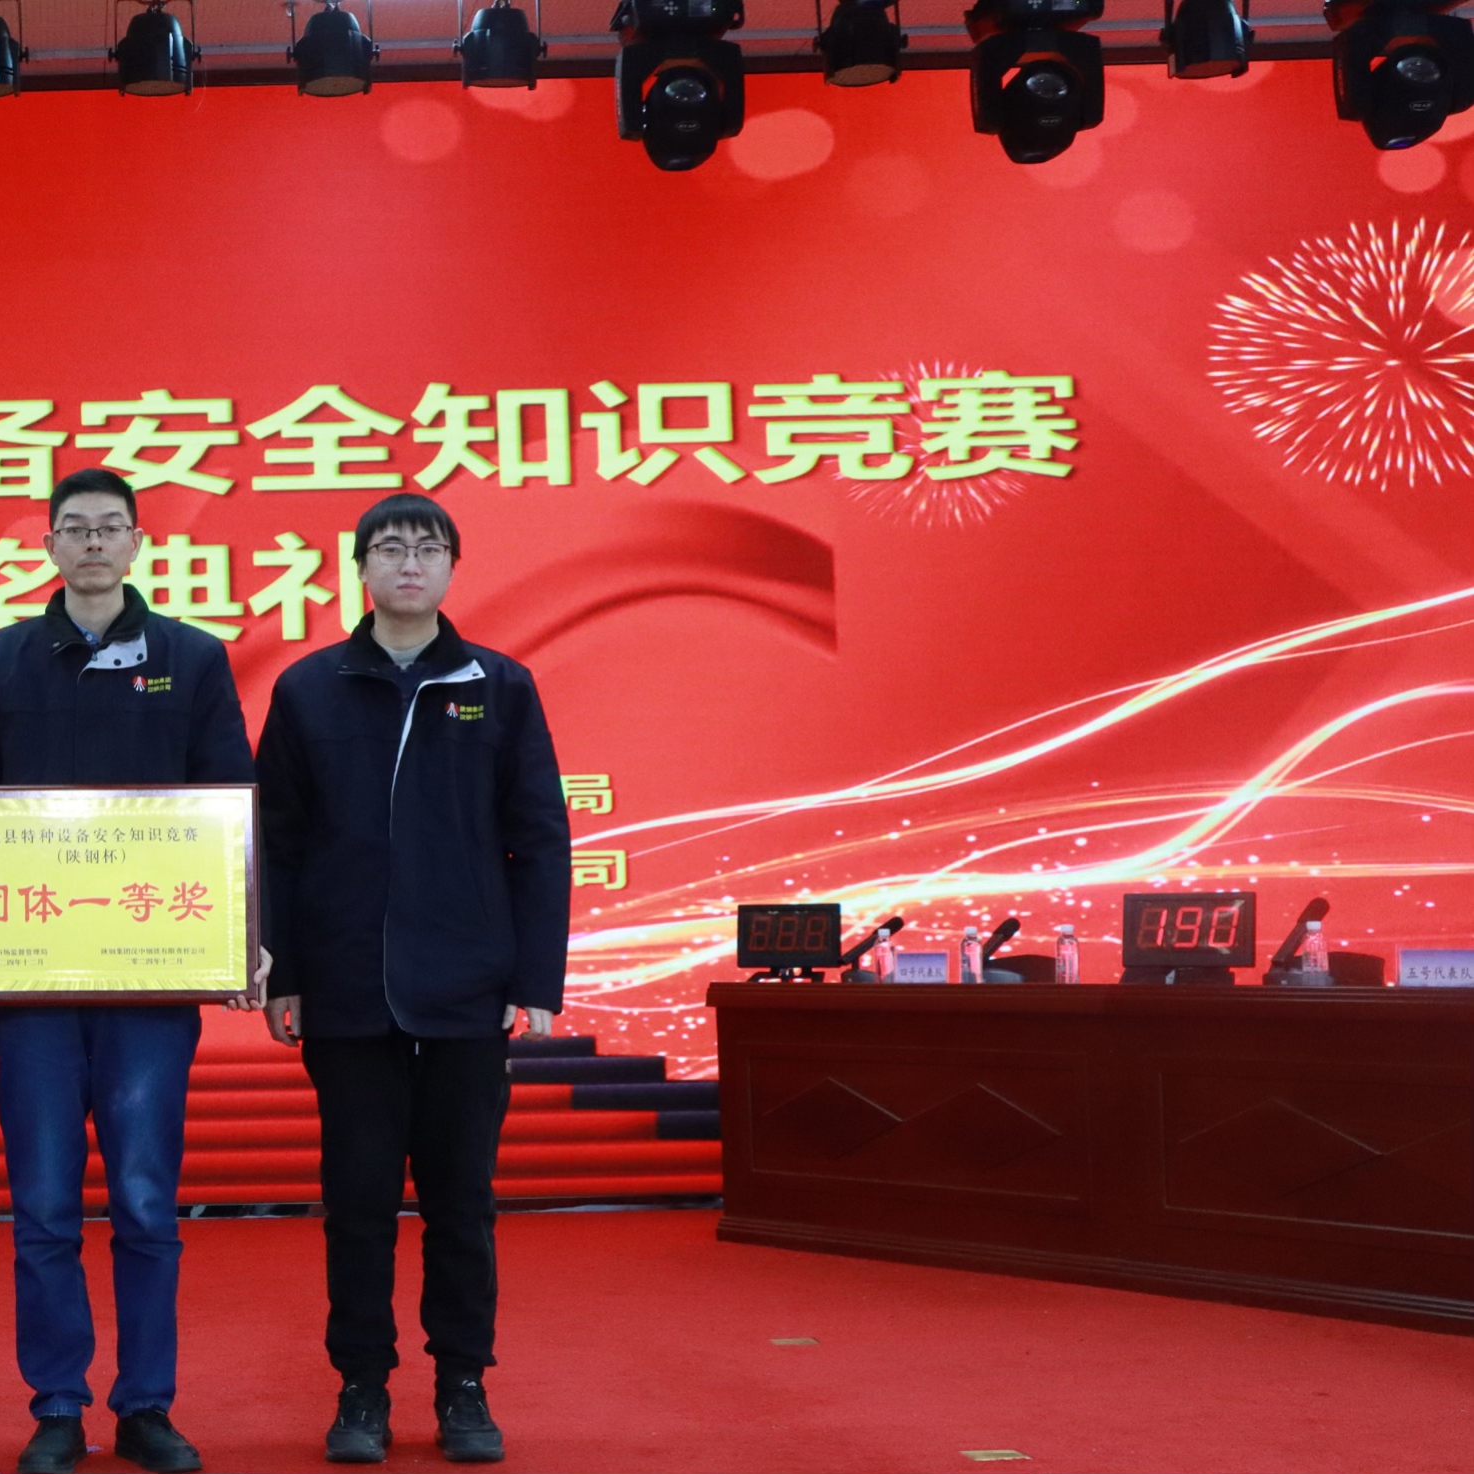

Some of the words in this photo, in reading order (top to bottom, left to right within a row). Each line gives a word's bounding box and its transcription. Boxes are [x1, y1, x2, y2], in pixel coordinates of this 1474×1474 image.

[57, 847, 127, 864] （陕钢杯）
[1155, 906, 1240, 948] 190
[1406, 966, 1473, 980] 五号代表队
